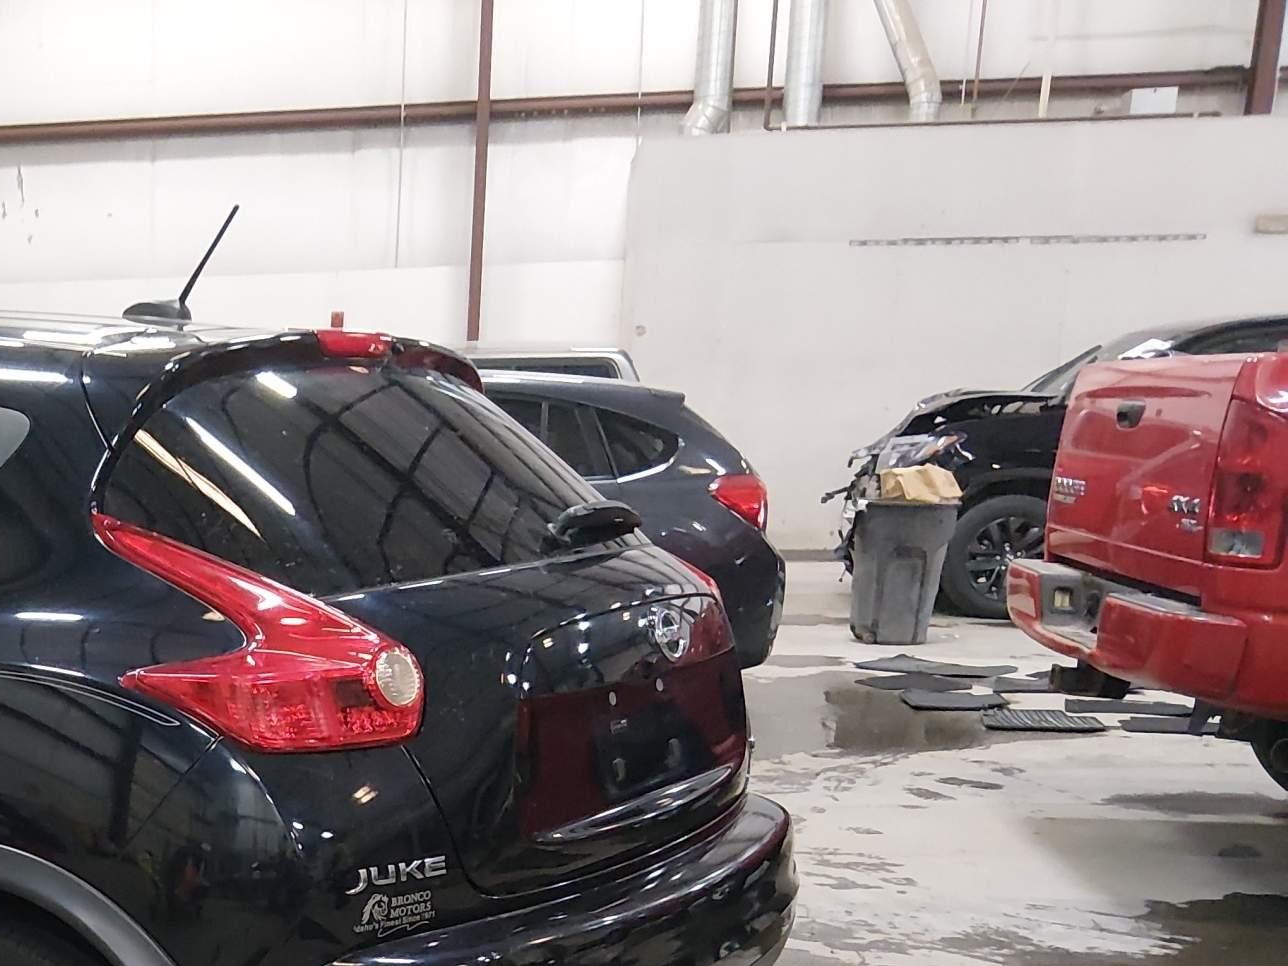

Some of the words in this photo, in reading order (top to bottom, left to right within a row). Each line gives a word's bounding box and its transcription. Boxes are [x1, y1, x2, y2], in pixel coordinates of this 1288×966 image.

[345, 855, 448, 895] JUKE
[391, 890, 432, 907] BRONCO
[390, 901, 432, 919] MOTORS
[402, 914, 421, 924] Since
